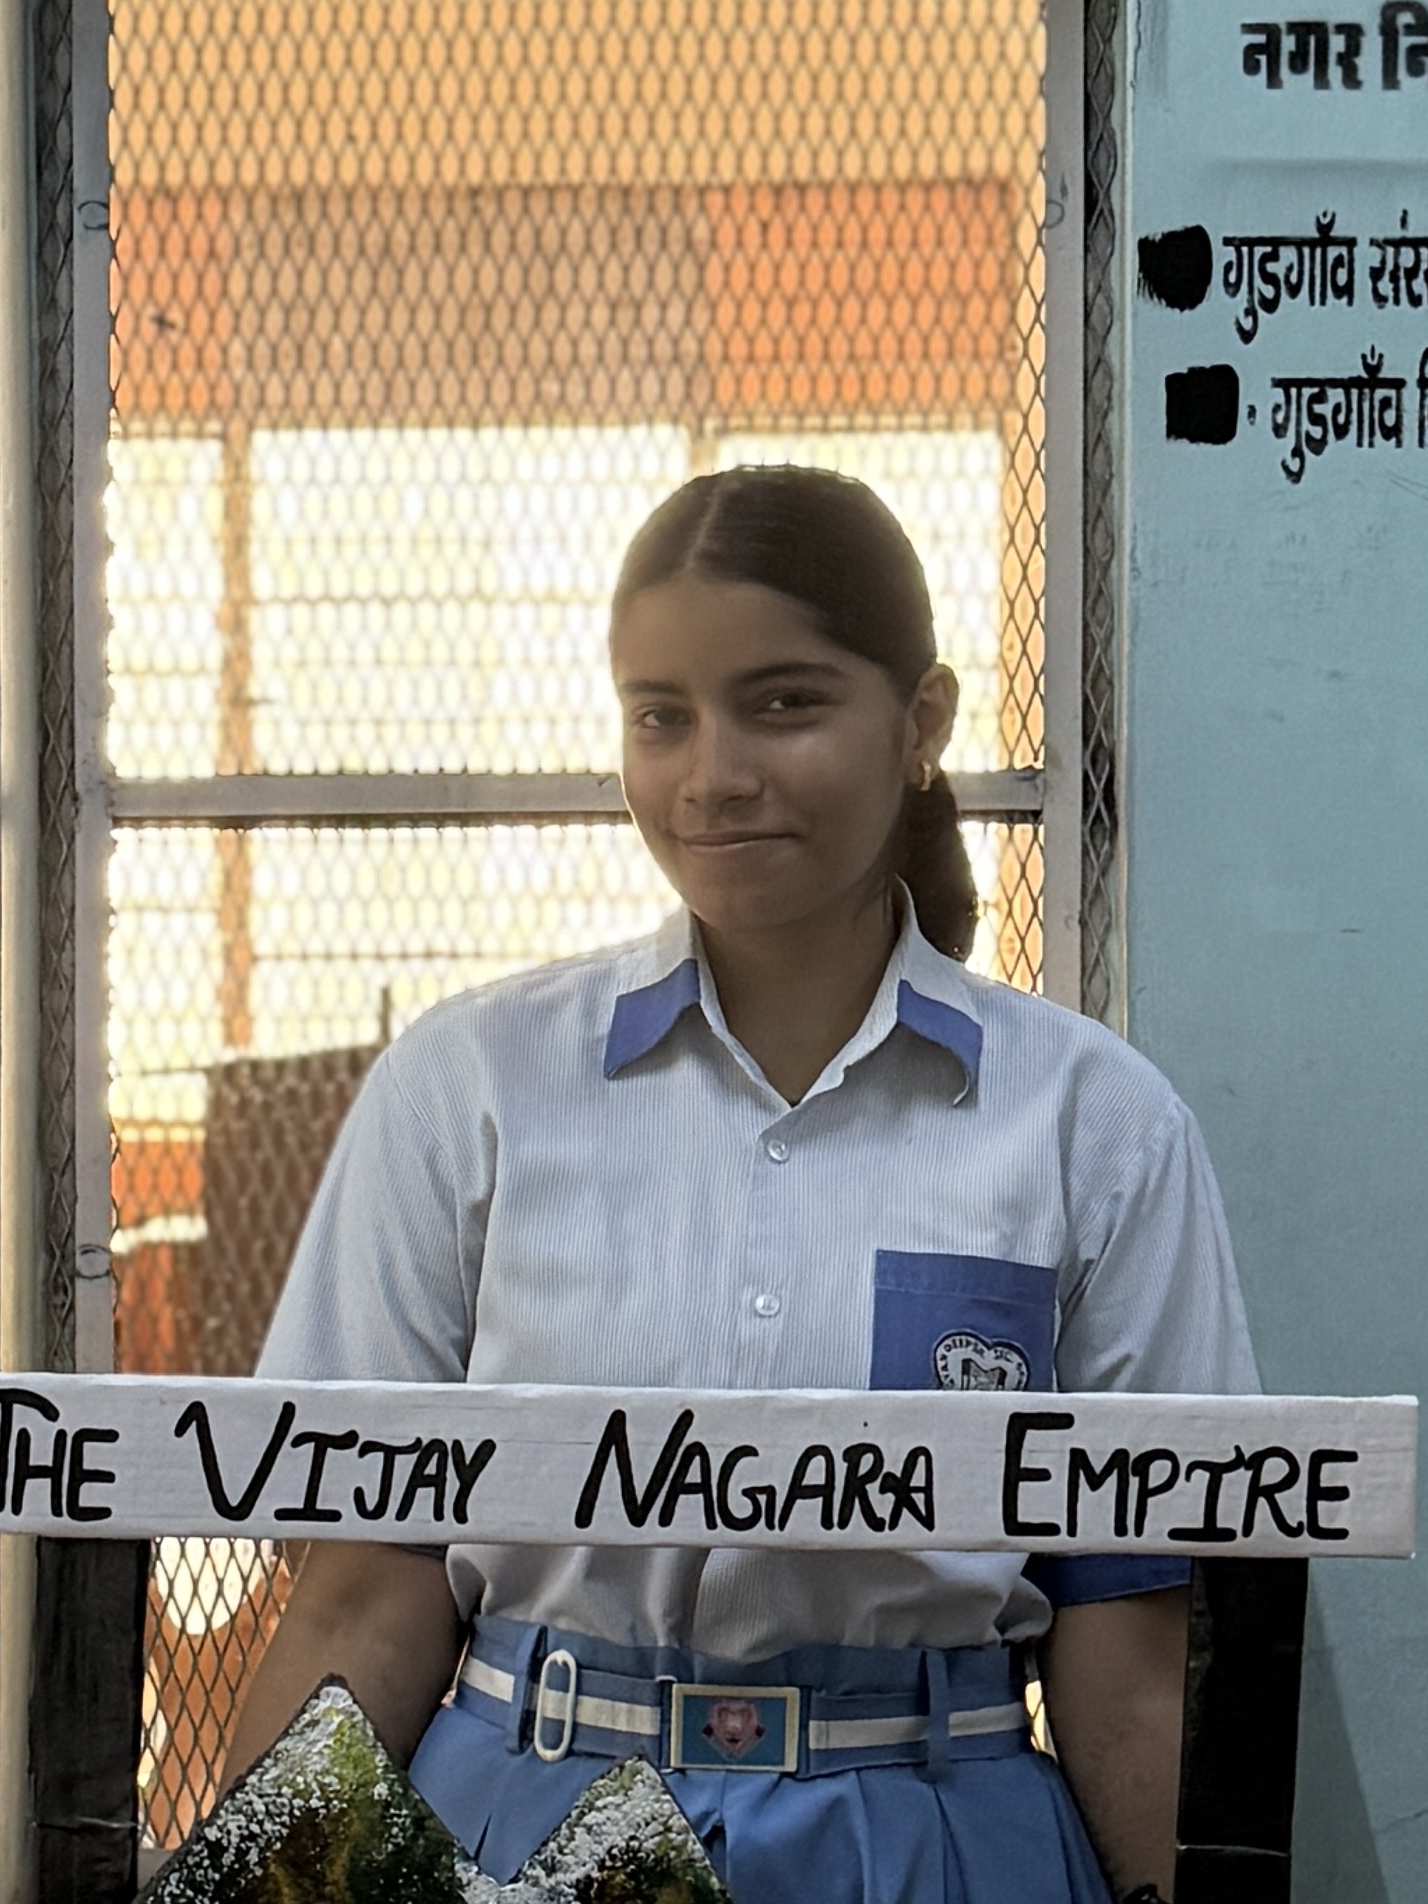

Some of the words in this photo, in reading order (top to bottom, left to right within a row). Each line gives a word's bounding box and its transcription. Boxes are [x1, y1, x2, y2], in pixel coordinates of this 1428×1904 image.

[1240, 22, 1364, 90] नगर
[172, 1399, 496, 1526] VIJAY
[572, 1408, 938, 1536] NAGARA
[1001, 1408, 1360, 1545] EMPIRE
